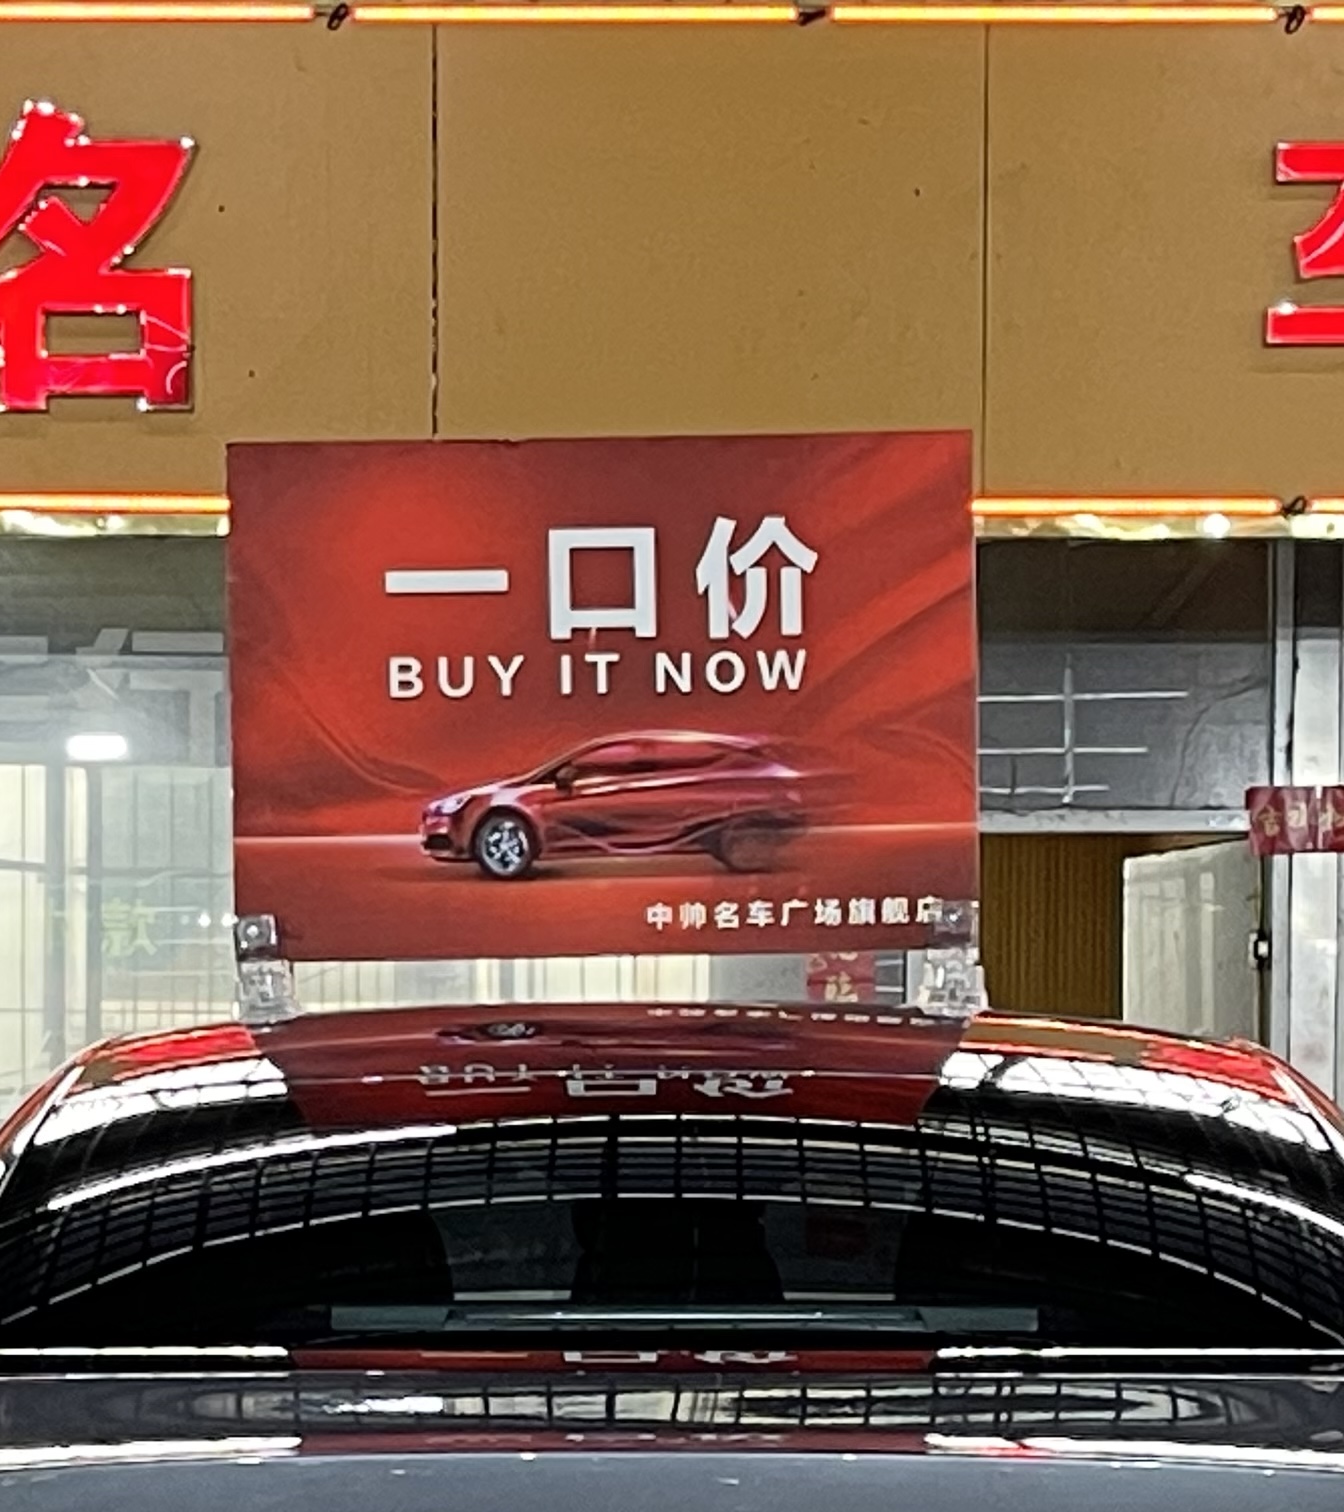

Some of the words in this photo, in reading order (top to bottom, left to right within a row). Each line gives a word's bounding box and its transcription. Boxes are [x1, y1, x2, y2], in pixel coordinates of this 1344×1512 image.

[385, 516, 818, 640] 一口价
[388, 655, 524, 699] BUY
[559, 652, 620, 694] IT
[654, 648, 808, 694] NOW
[646, 895, 944, 931] 中帅名车广场旗舰店
